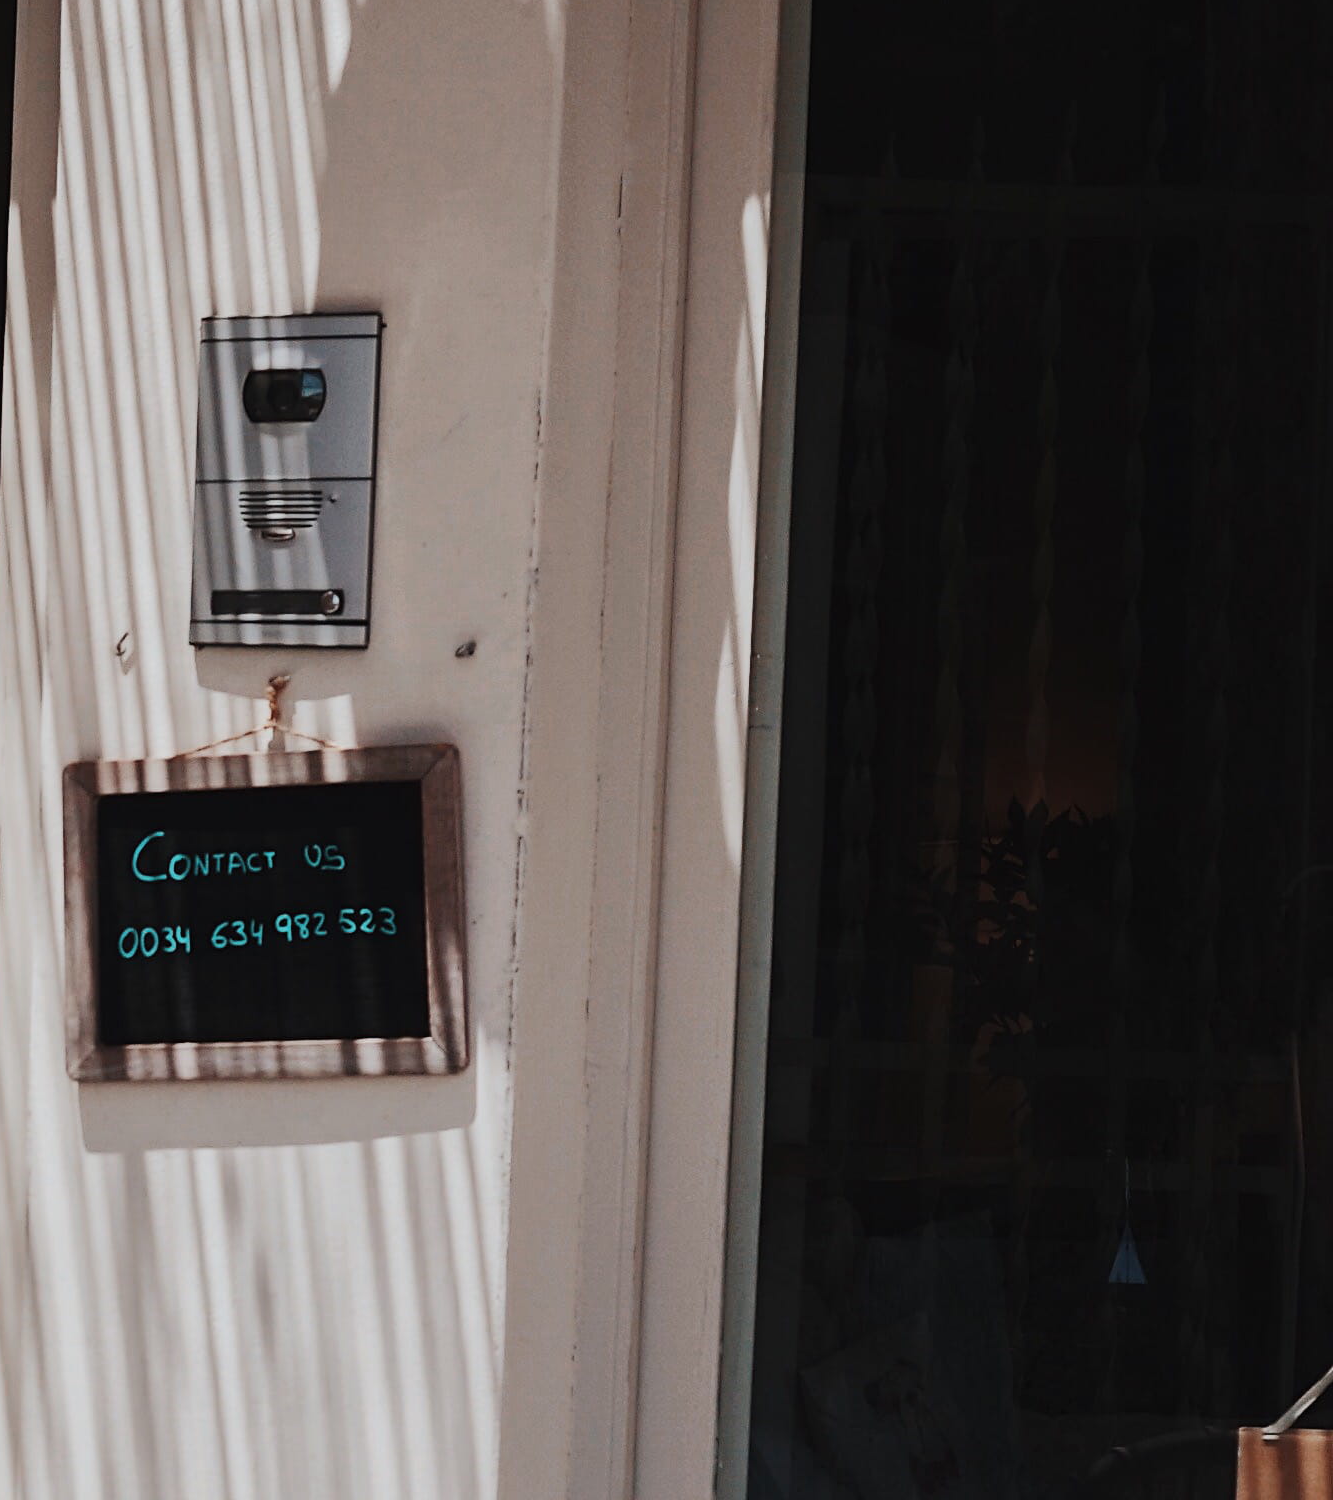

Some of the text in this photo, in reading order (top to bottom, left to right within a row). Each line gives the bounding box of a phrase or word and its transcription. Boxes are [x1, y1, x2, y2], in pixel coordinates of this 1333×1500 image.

[302, 844, 346, 871] US
[117, 906, 397, 959] 0034 634 982 523
